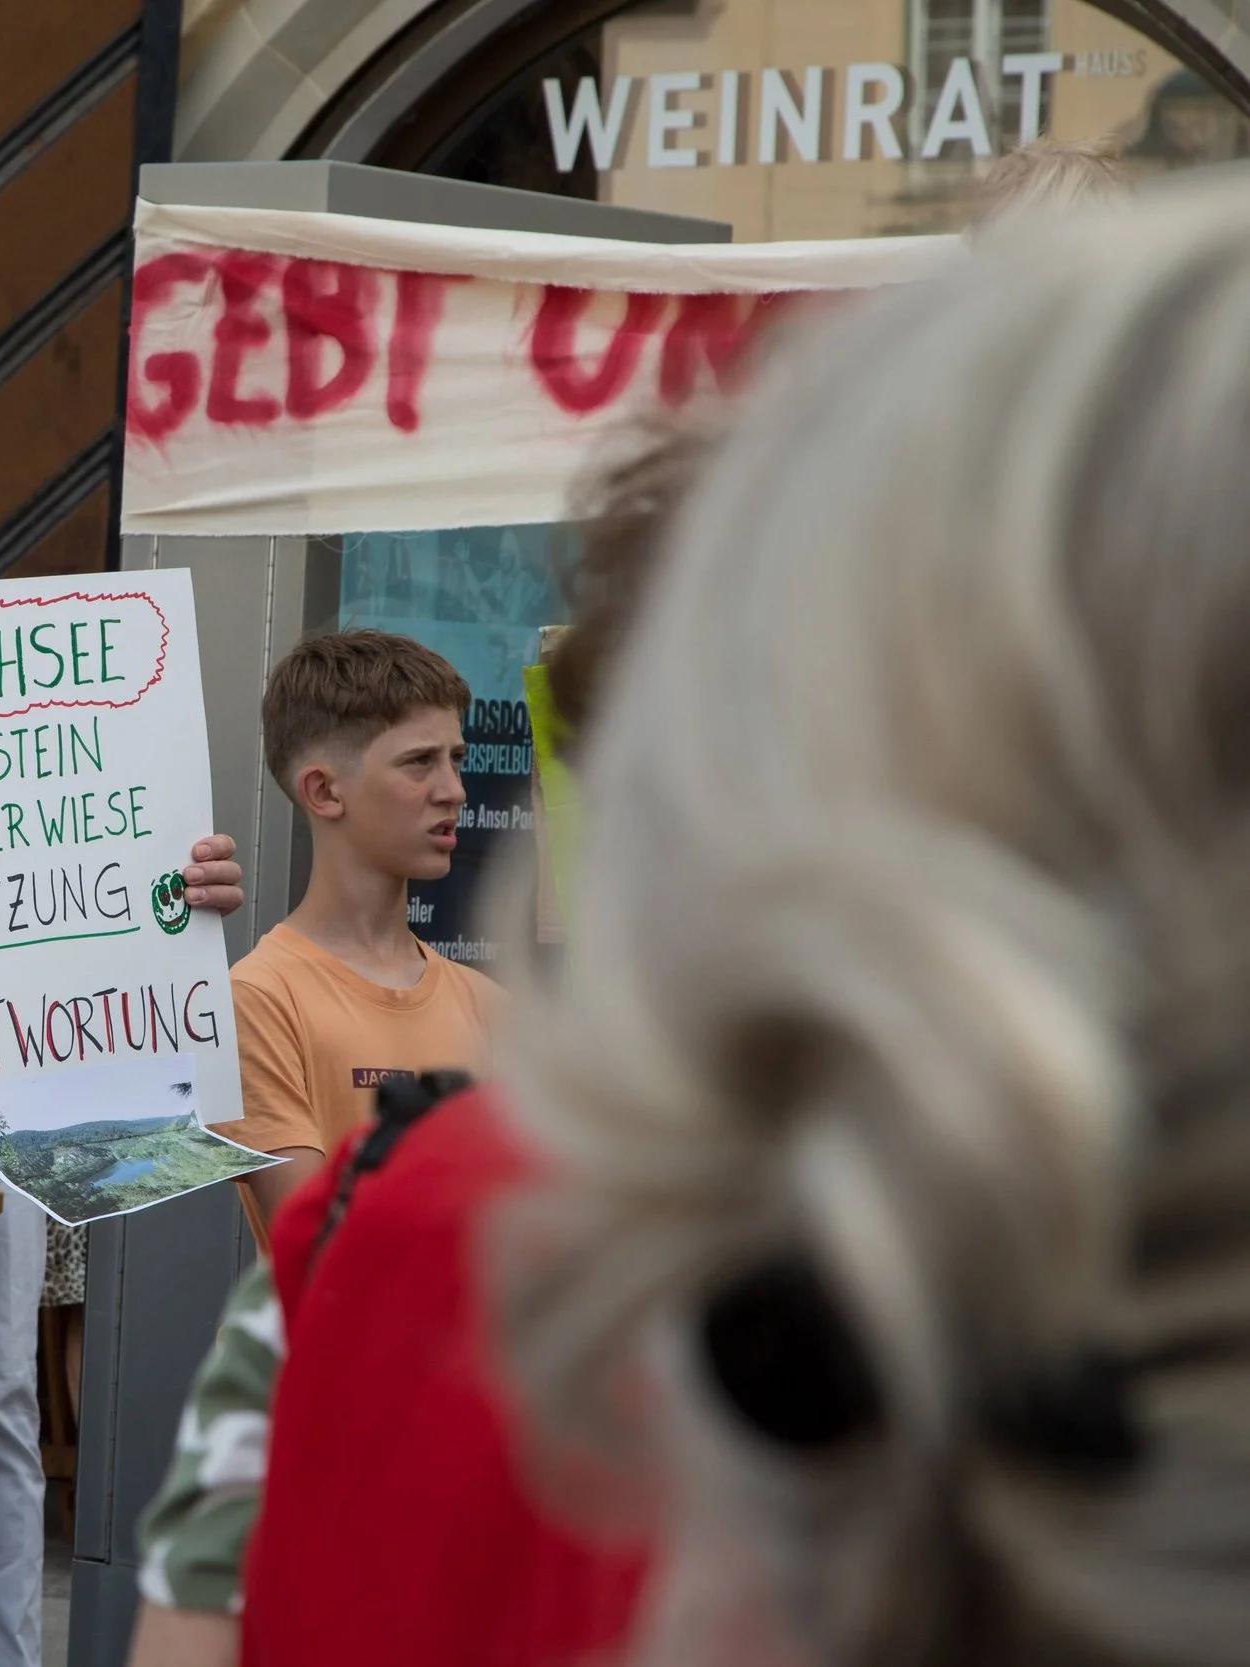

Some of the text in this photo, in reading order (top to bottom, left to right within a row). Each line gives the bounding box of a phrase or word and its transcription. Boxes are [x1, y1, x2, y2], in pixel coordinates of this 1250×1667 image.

[543, 53, 1064, 172] WEINRAT
[530, 284, 780, 416] UN
[461, 741, 532, 775] ERSPIELBÜ
[477, 804, 509, 829] Ansa
[407, 896, 435, 923] eiler
